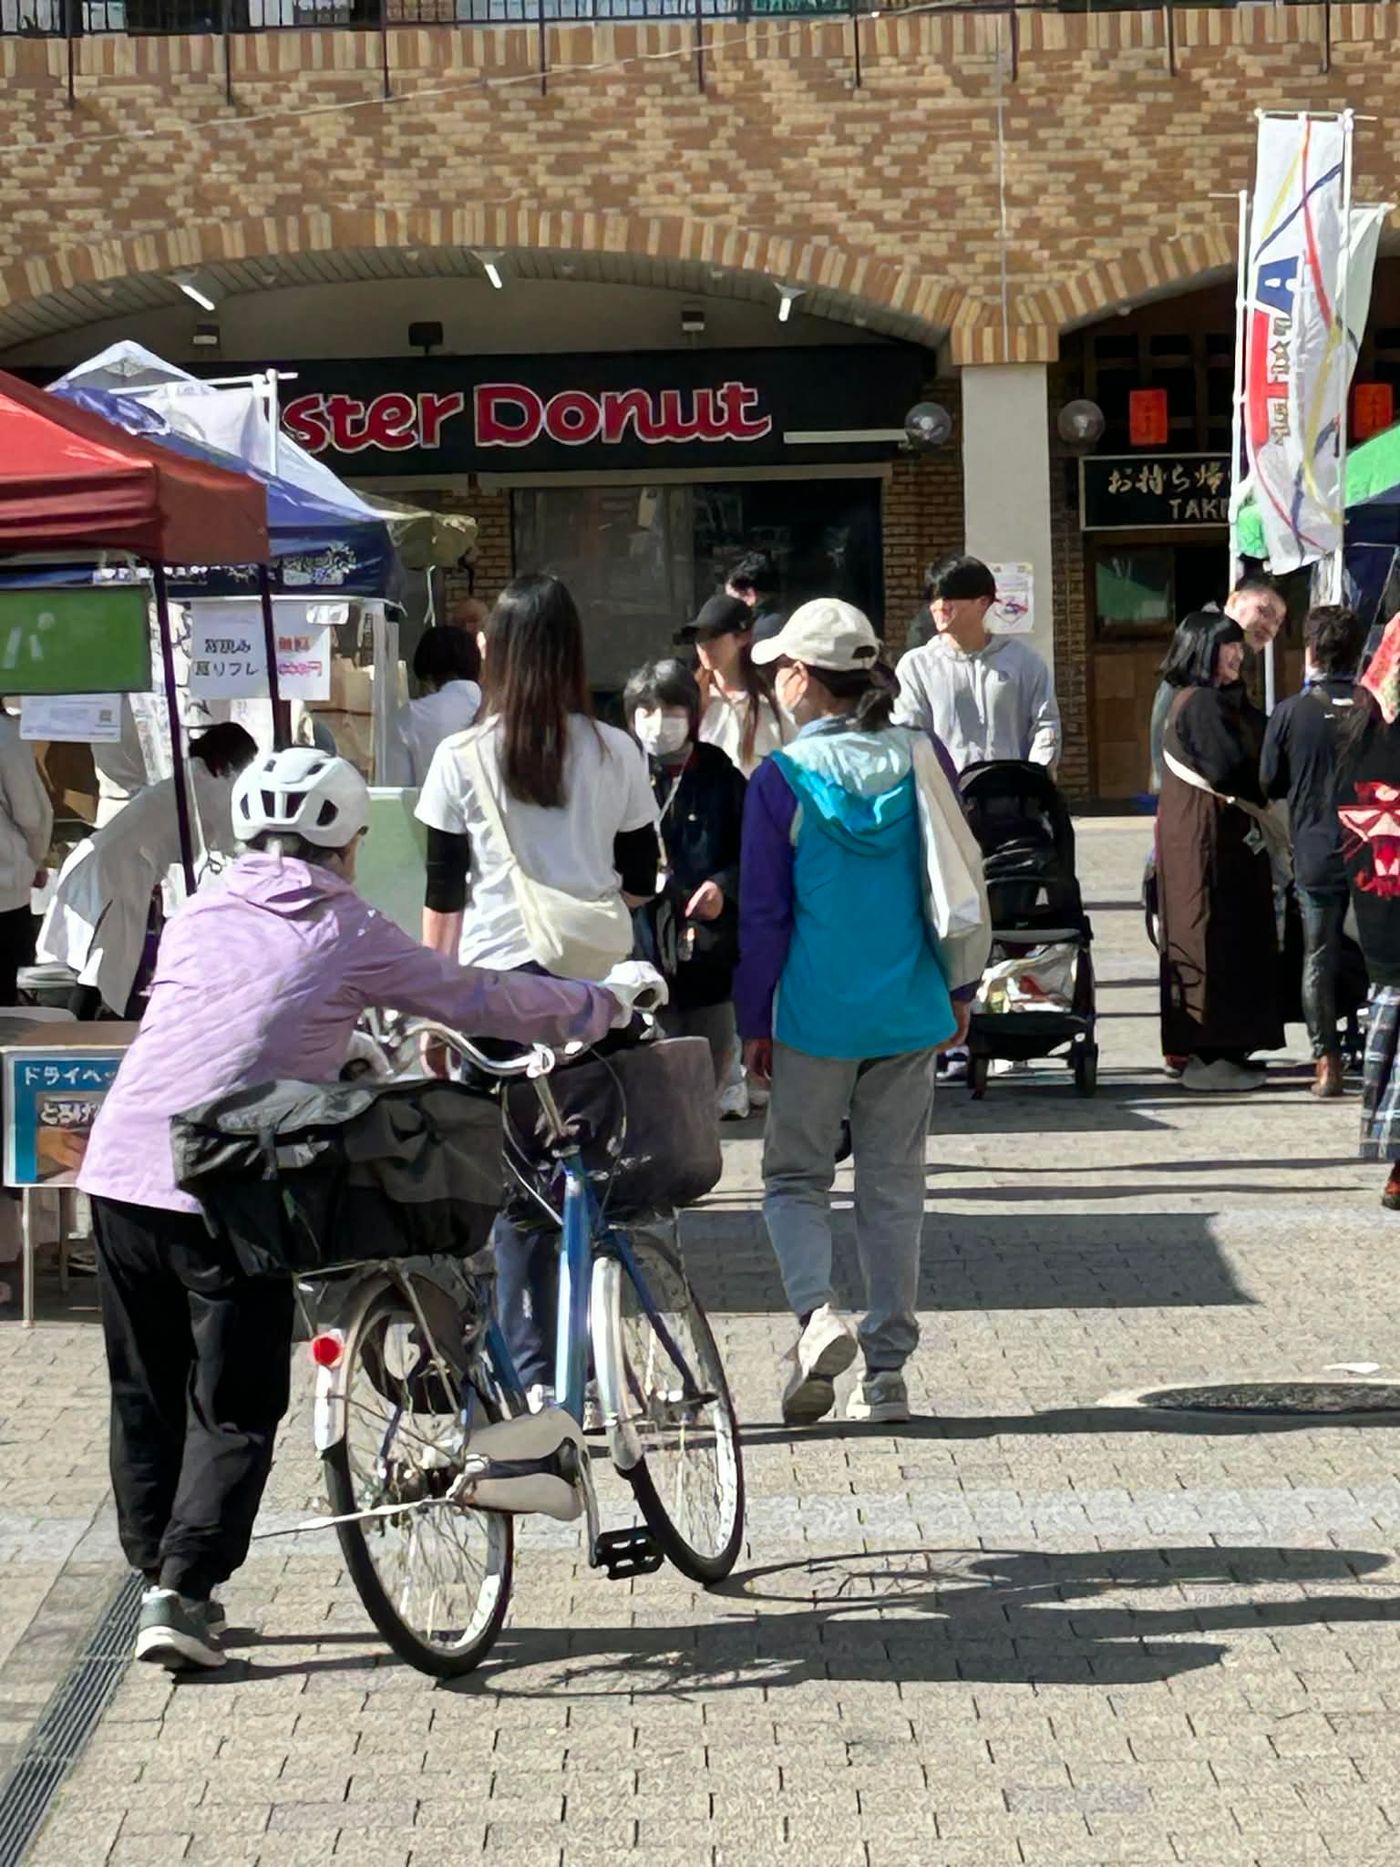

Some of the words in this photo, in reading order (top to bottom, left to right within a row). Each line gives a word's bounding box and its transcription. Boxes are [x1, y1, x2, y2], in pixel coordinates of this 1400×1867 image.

[473, 382, 772, 447] Donut
[1107, 461, 1231, 495] お持ち帰
